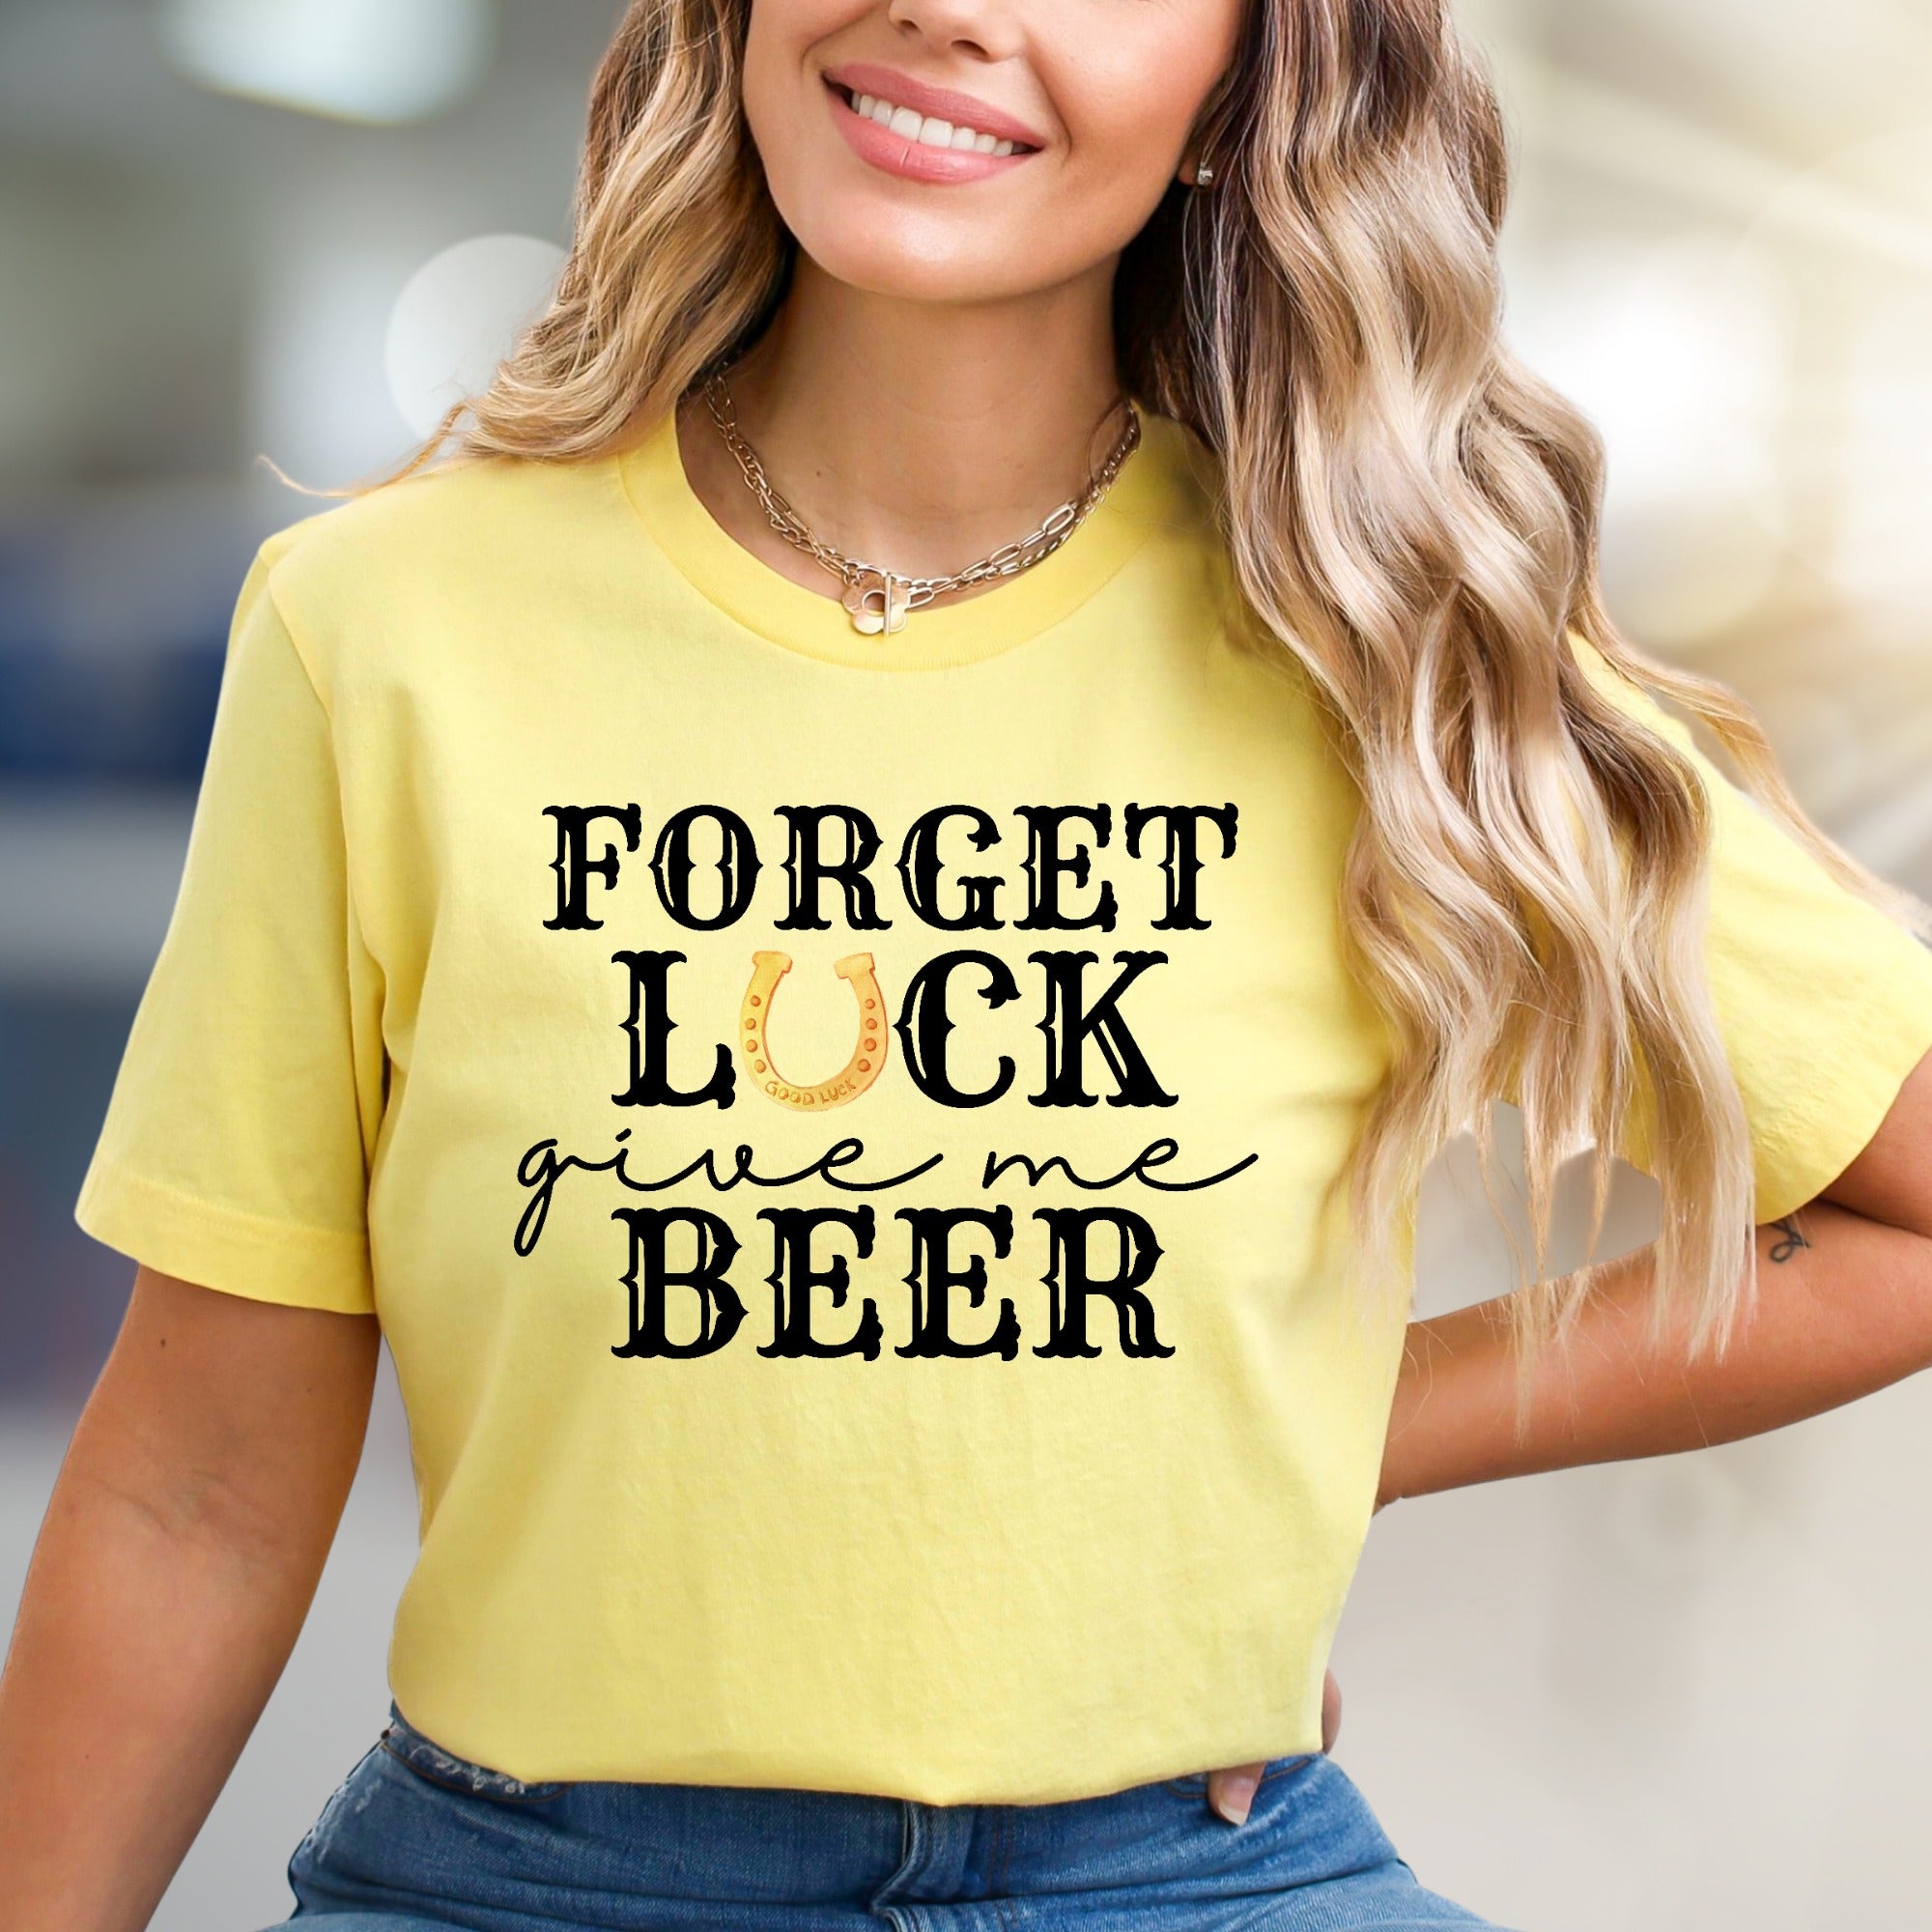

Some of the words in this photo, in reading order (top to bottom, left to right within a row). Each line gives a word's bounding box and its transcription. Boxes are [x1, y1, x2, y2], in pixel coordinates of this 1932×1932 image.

[542, 803, 1238, 932] FORGET
[611, 951, 1179, 1111] LUCK
[765, 1081, 815, 1105] GOOD
[819, 1078, 857, 1104] LUCK
[513, 1127, 944, 1258] give
[981, 1137, 1259, 1192] me
[611, 1205, 1175, 1361] BEER
